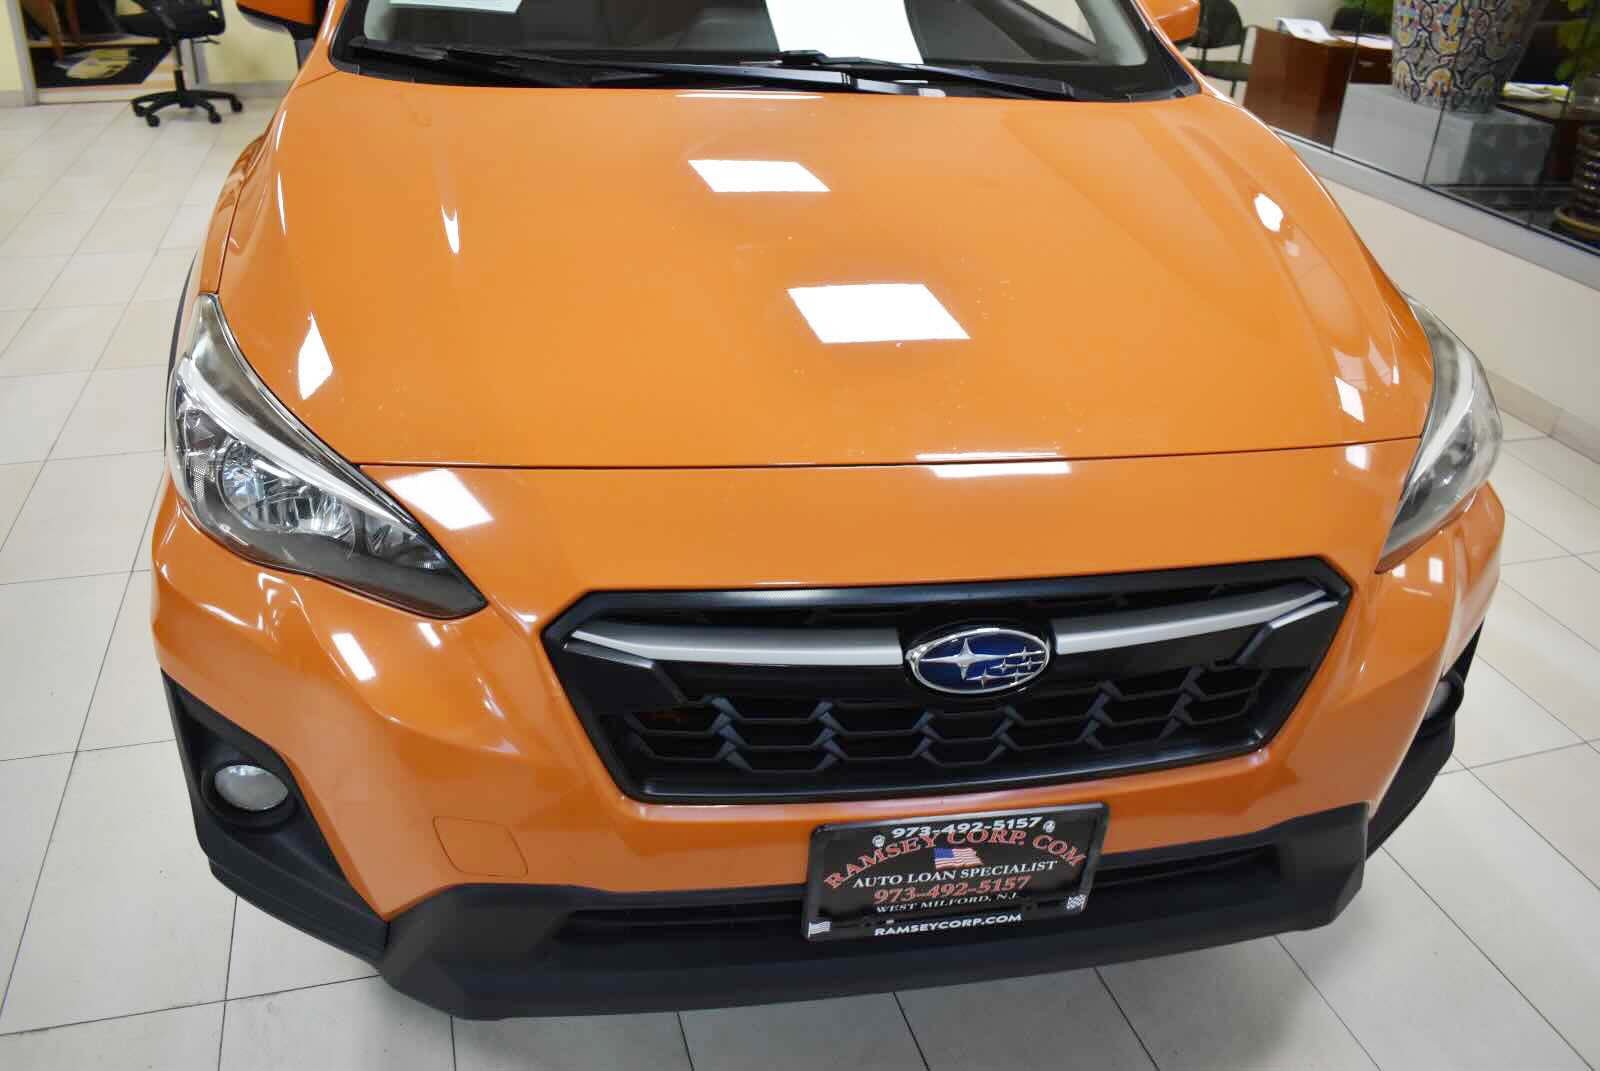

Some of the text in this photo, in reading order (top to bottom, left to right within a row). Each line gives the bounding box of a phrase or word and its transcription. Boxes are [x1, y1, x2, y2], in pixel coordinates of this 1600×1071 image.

[890, 816, 1044, 839] 973-492-5157
[824, 830, 941, 888] RAMSEY
[1032, 834, 1087, 867] COM
[852, 860, 1059, 889] AUTO LOAN SPECIALIST
[873, 875, 1033, 904] 973-492-5157
[875, 902, 918, 913] WEST
[874, 913, 1023, 936] RAMSEYCORP.COM
